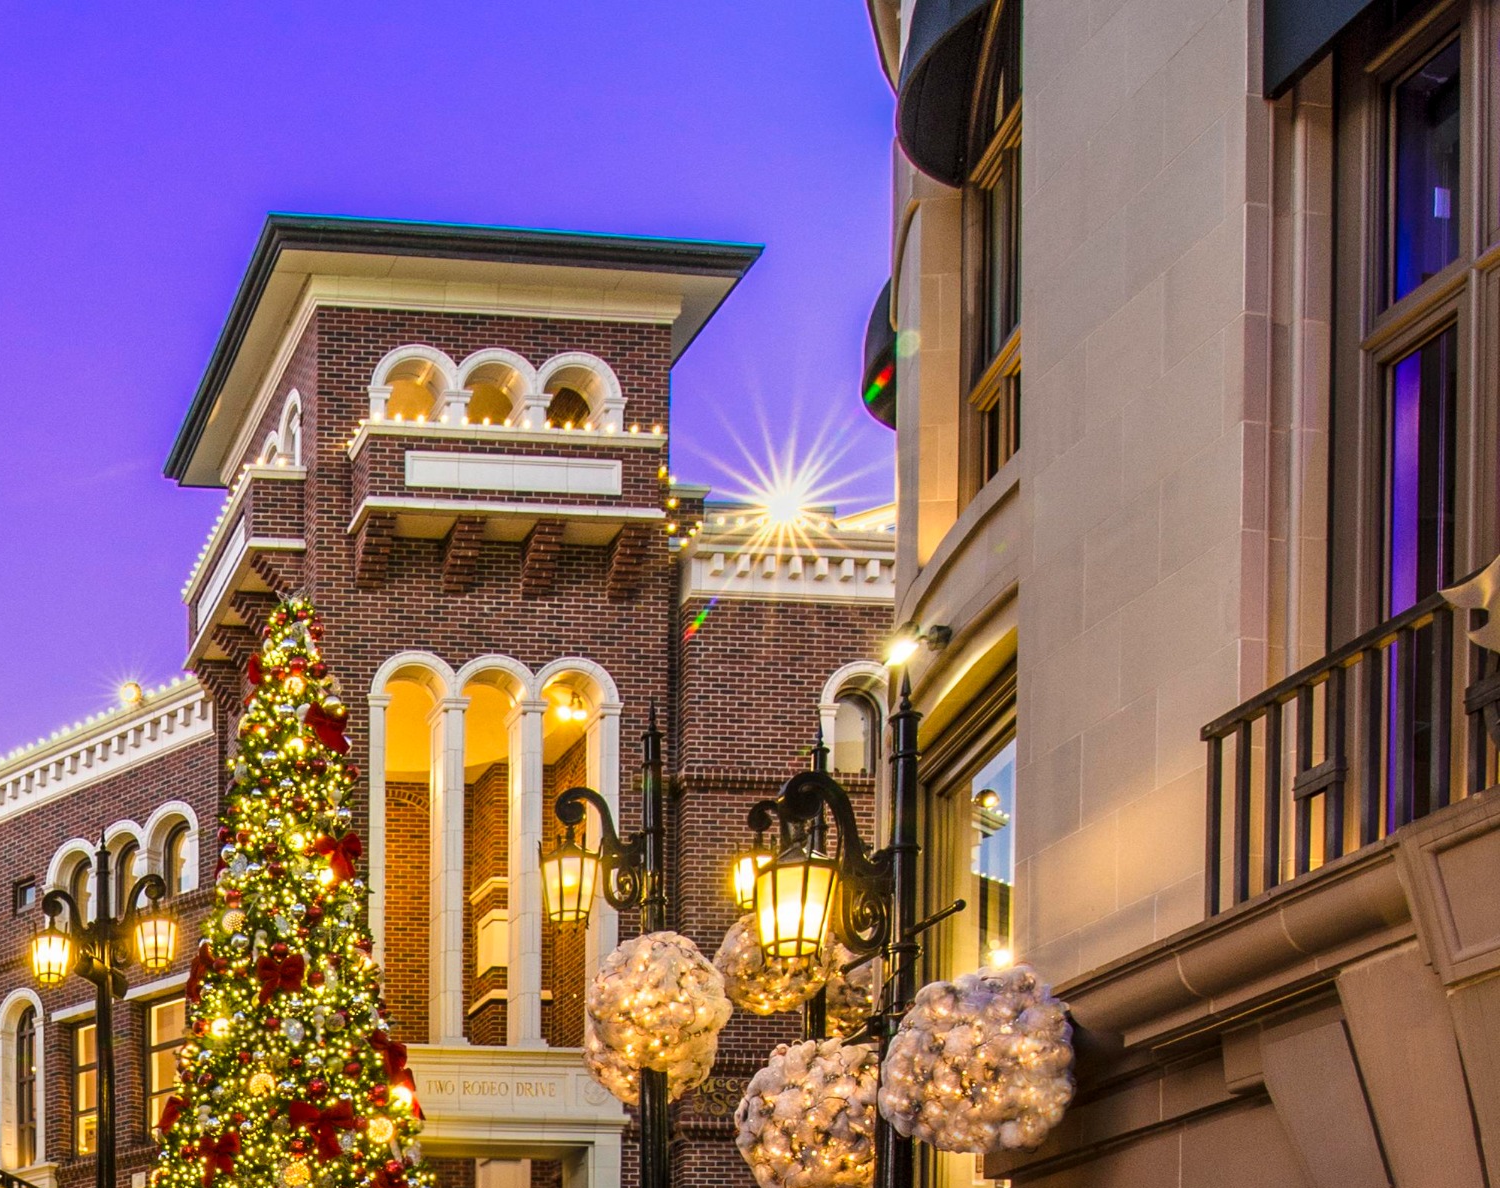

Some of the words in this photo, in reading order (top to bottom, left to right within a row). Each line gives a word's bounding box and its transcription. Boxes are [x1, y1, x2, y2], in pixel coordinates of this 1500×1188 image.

[426, 1080, 454, 1096] TWO
[462, 1080, 509, 1097] RODEO
[516, 1082, 556, 1098] DRIVE
